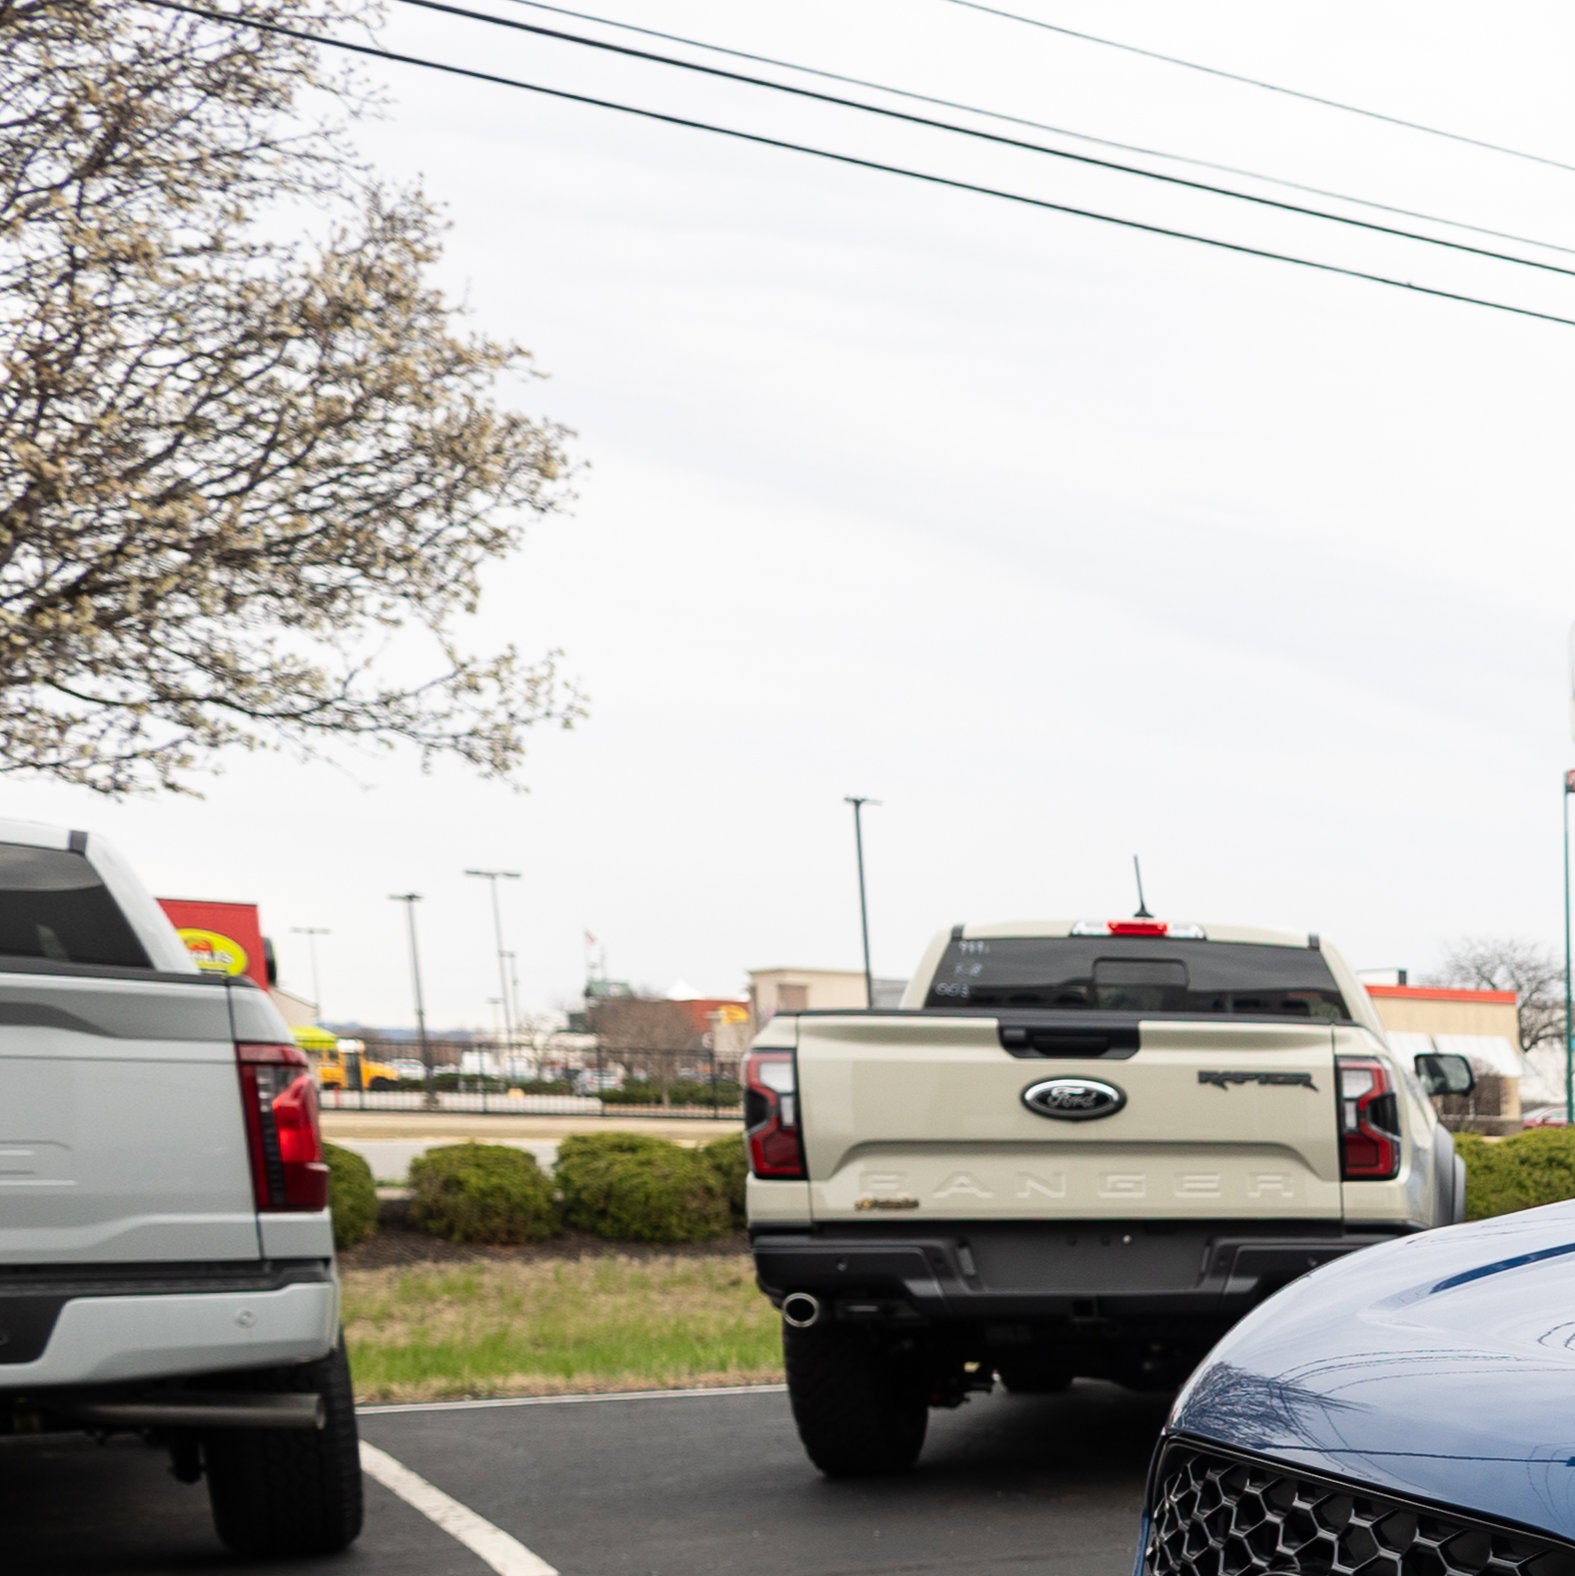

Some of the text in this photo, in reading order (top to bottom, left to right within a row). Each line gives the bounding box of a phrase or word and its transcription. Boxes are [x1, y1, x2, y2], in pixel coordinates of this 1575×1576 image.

[1197, 1071, 1319, 1093] RAPTOR
[1047, 1086, 1097, 1108] Ford
[858, 1169, 1296, 1199] RANGER
